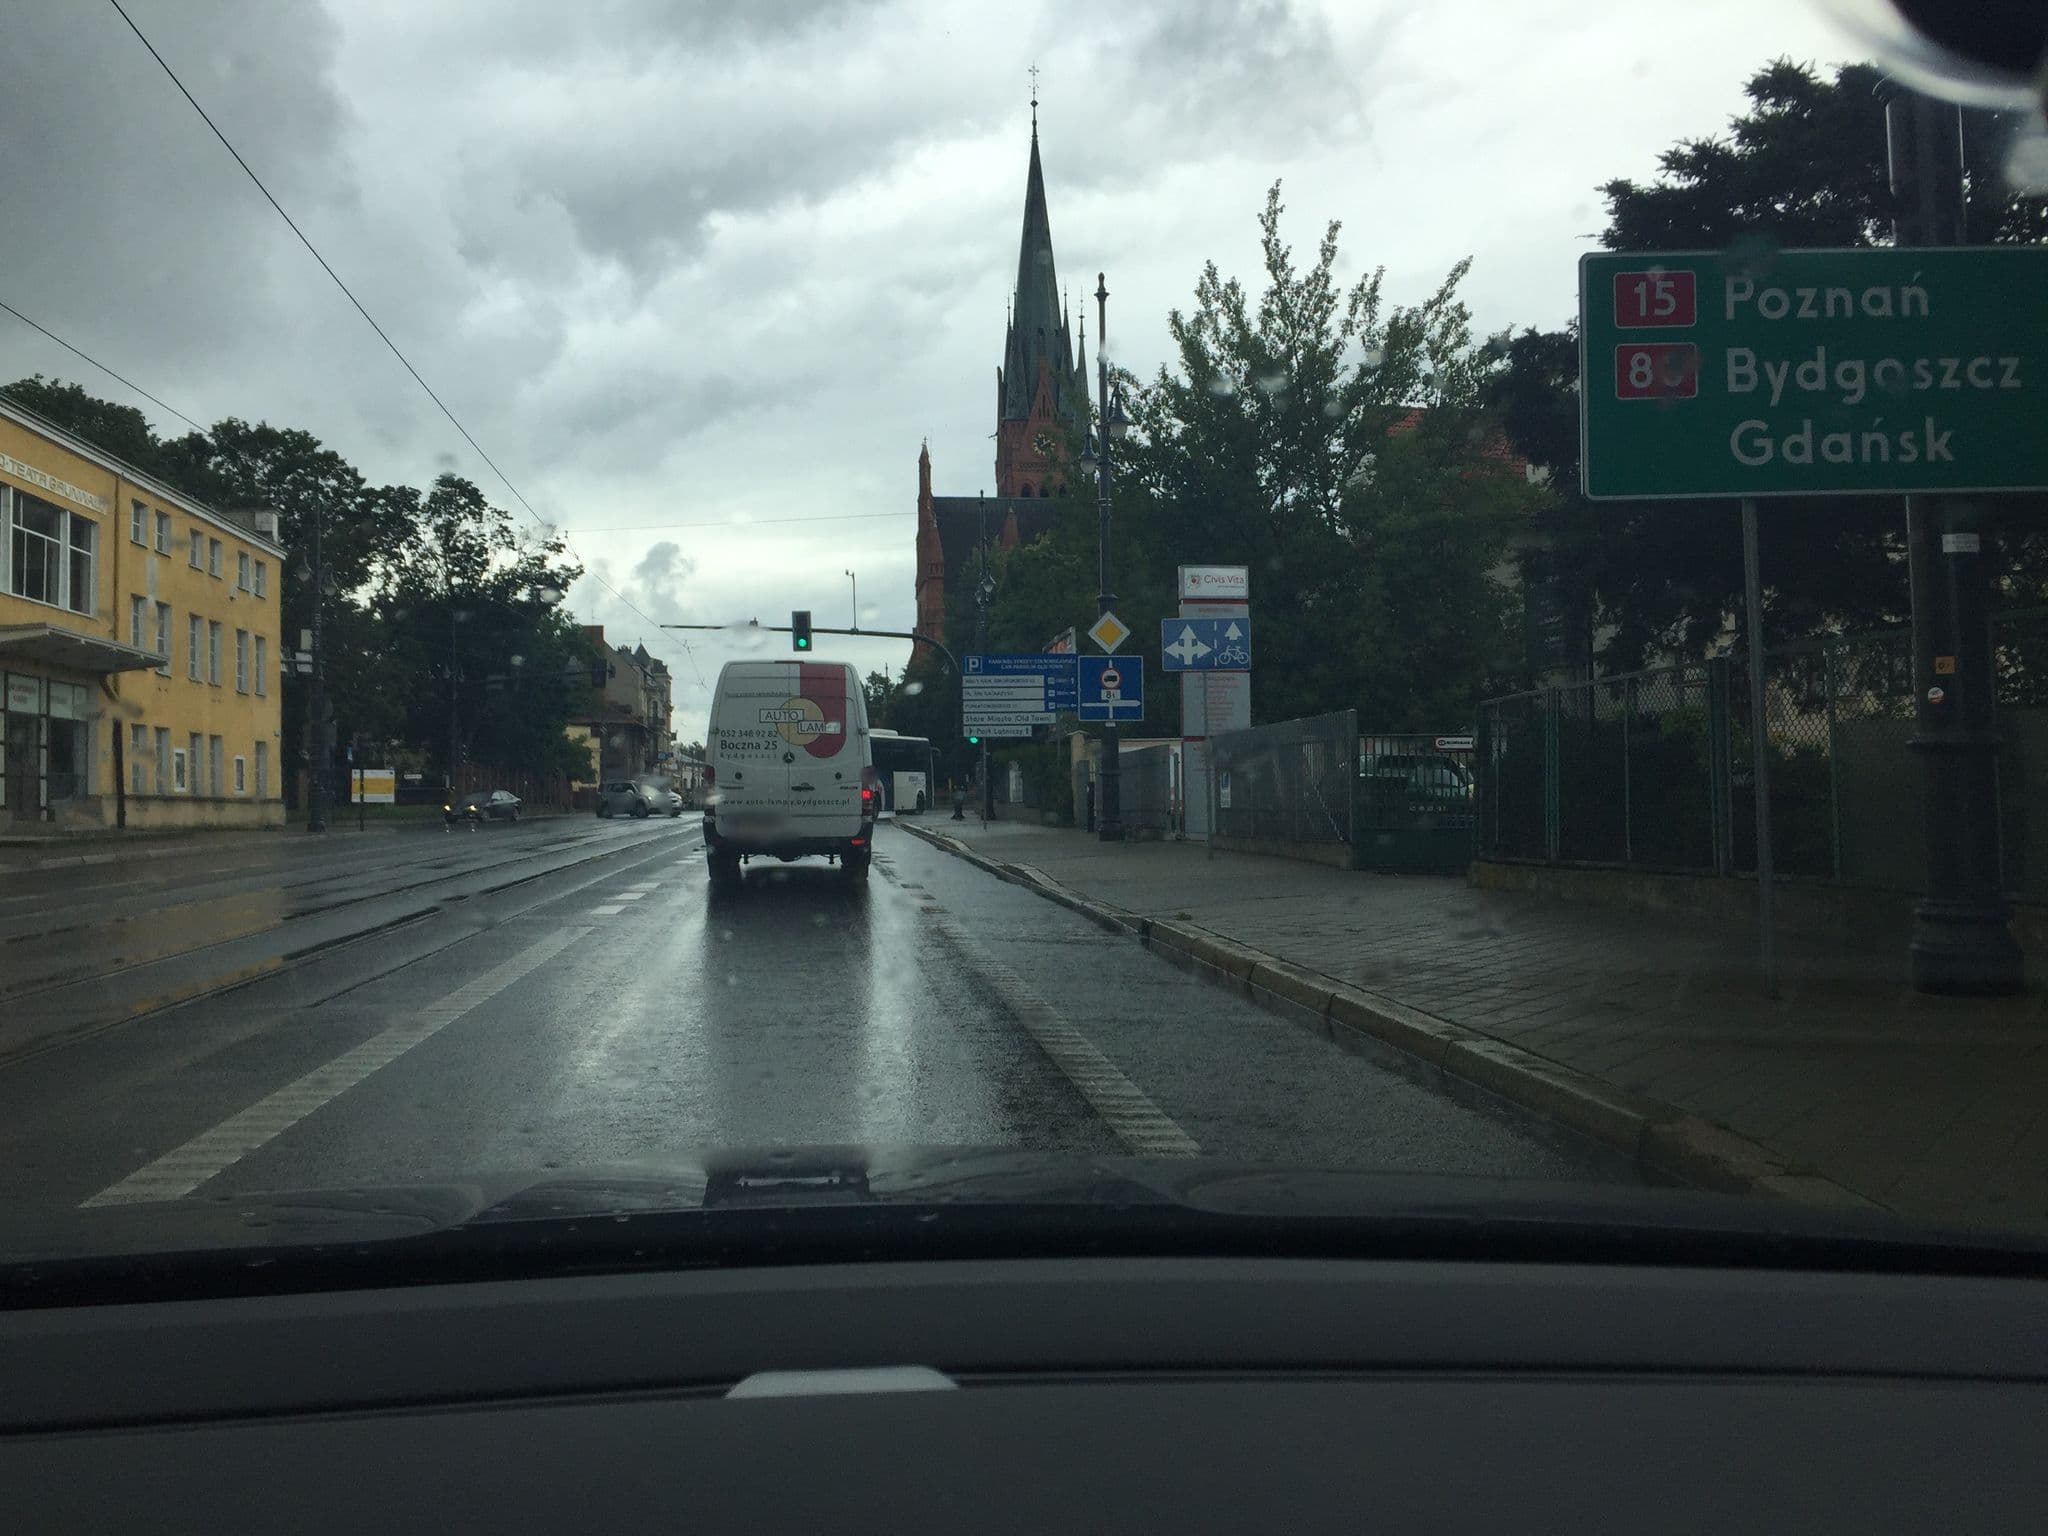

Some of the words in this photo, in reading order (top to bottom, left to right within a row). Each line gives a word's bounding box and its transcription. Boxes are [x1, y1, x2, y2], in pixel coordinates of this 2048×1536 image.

[1633, 279, 1677, 317] 15
[1725, 271, 1930, 320] Poznań
[1726, 345, 2022, 407] Bydgoszcz
[1729, 415, 1954, 466] Gdańsk
[1204, 574, 1226, 584] Civis
[1226, 575, 1245, 584] Vita
[765, 711, 799, 721] AUTO
[720, 739, 761, 750] Boczna
[764, 740, 778, 750] 25
